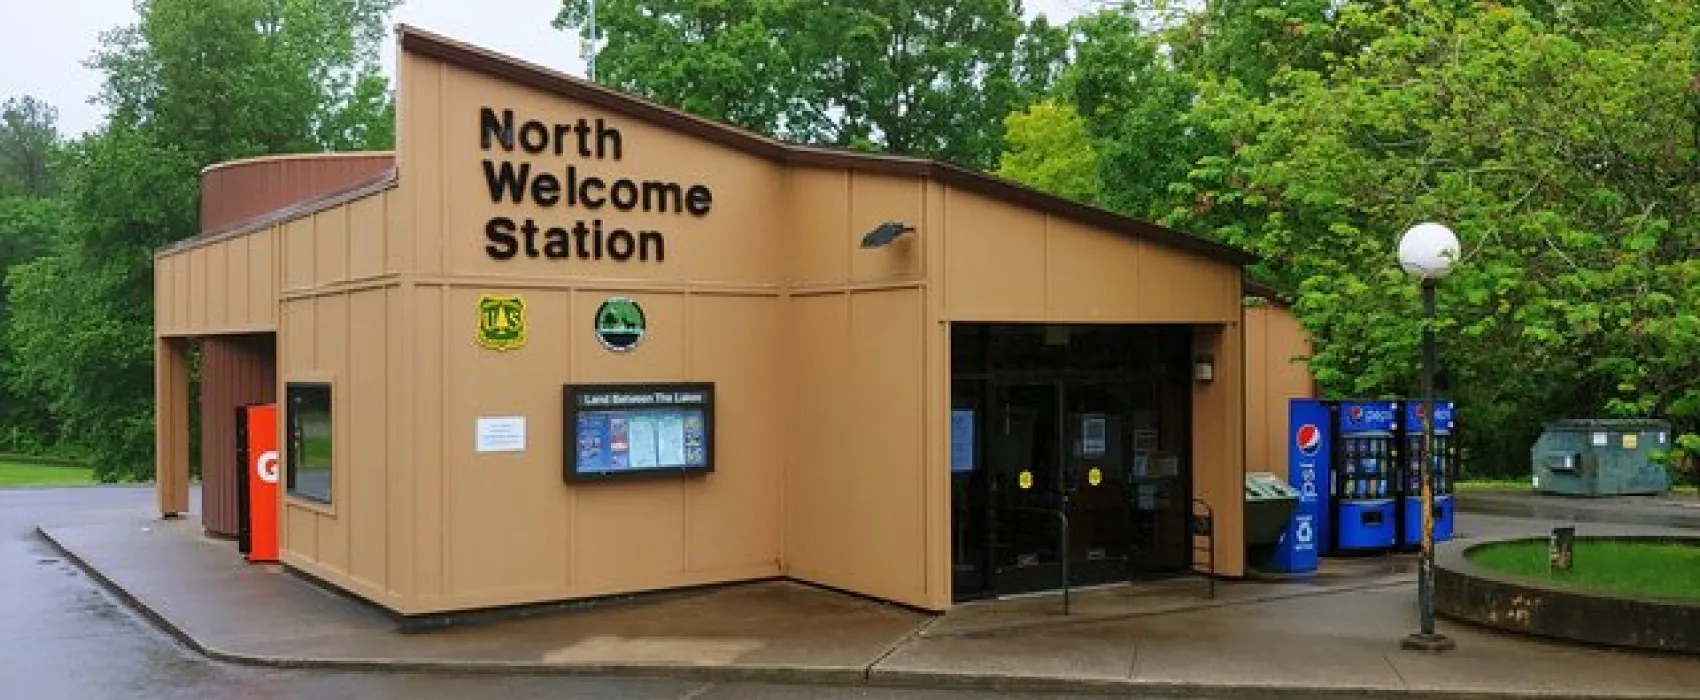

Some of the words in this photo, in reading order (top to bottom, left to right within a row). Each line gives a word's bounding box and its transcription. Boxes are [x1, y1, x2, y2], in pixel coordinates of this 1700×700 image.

[479, 106, 622, 161] North
[482, 160, 712, 217] Welcome
[485, 216, 665, 262] Station
[583, 393, 609, 404] Land
[612, 393, 654, 404] Between
[655, 392, 673, 404] The
[674, 391, 702, 404] Lakes
[257, 451, 279, 483] G
